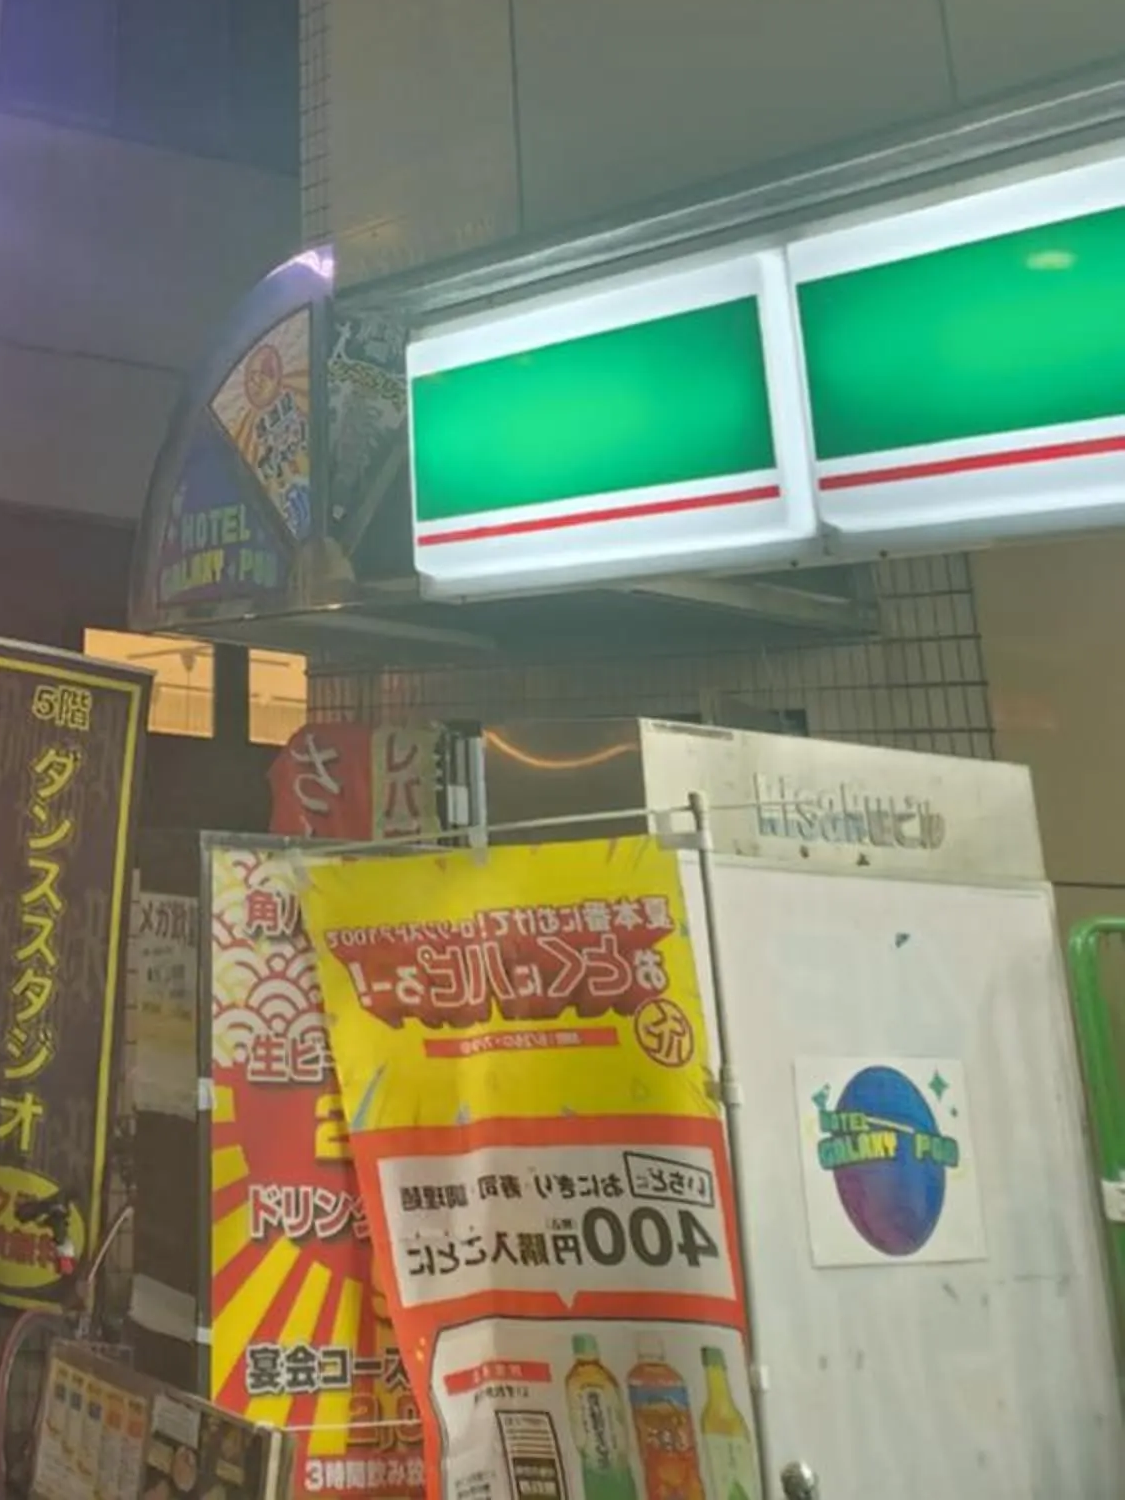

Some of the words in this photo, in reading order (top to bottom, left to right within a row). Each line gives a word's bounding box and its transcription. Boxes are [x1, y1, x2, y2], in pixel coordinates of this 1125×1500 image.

[181, 503, 252, 550] HOTEL
[30, 683, 94, 732] 5階
[819, 1110, 871, 1134] HOTEL
[818, 1130, 898, 1170] GALAXY
